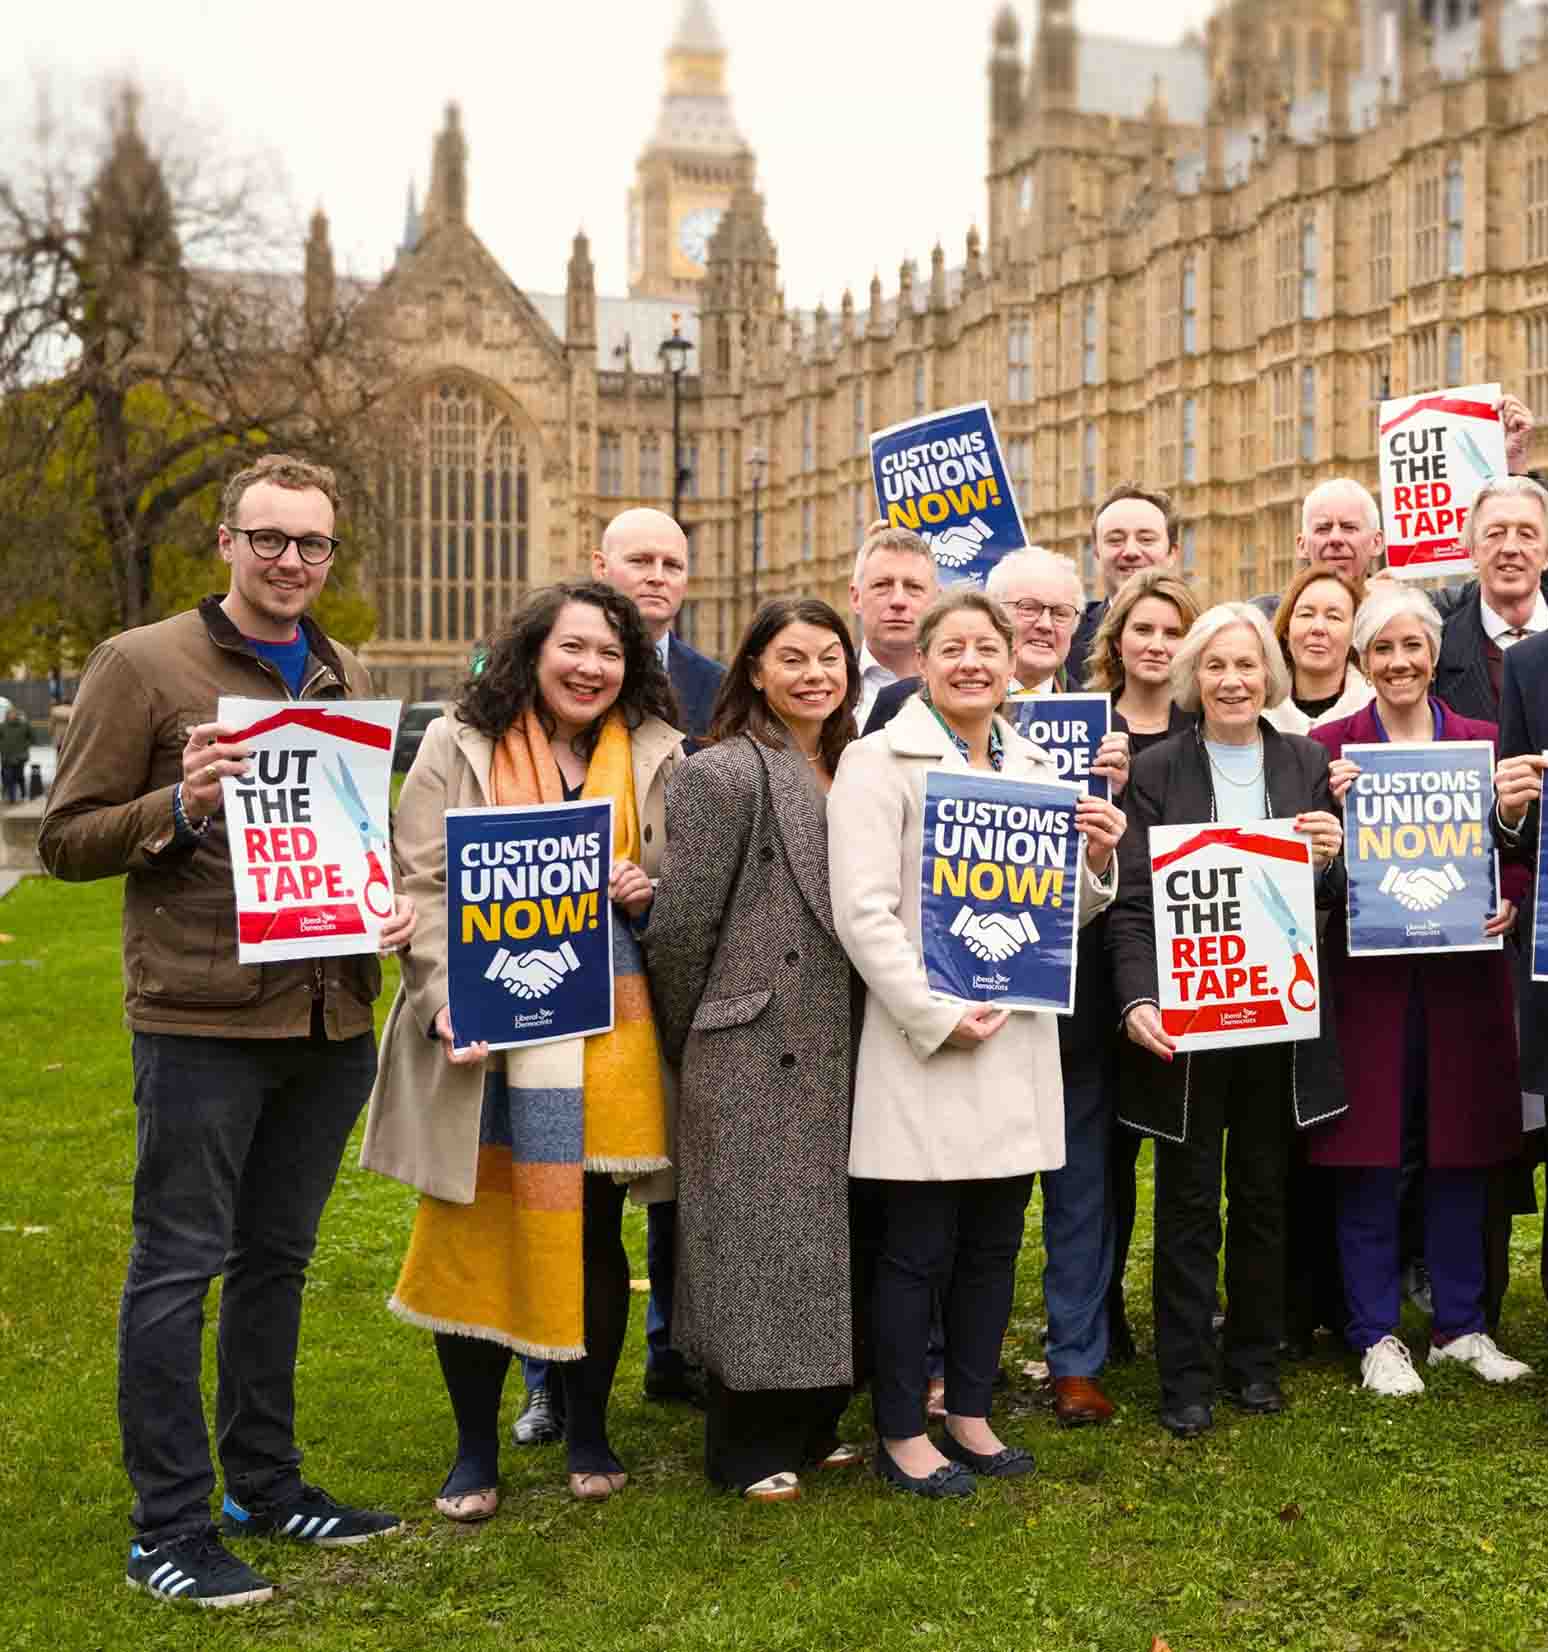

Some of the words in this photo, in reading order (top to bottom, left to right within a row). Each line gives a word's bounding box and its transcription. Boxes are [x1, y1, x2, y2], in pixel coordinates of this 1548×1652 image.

[881, 431, 986, 475] CUSTOMS
[1389, 427, 1447, 457] CUT
[883, 452, 993, 502] UNION
[1390, 454, 1448, 483] THE
[887, 477, 1002, 529] NOW!
[1394, 482, 1452, 511] RED
[1029, 720, 1090, 744] OUR
[1356, 770, 1480, 795] CUSTOMS
[236, 788, 311, 823] THE
[937, 799, 1070, 834] CUSTOMS
[1356, 792, 1481, 824] UNION
[244, 827, 317, 863] RED
[461, 832, 600, 868] CUSTOMS
[934, 823, 1067, 868] UNION
[1359, 823, 1483, 860] NOW!
[248, 864, 354, 902] TAPE.
[461, 858, 600, 902] UNION
[932, 857, 1065, 908] NOW!
[1165, 866, 1242, 901] CUT
[462, 891, 599, 943] NOW!
[1167, 901, 1241, 934] THE
[1172, 934, 1246, 968] RED
[1172, 965, 1279, 1002] TAPE.
